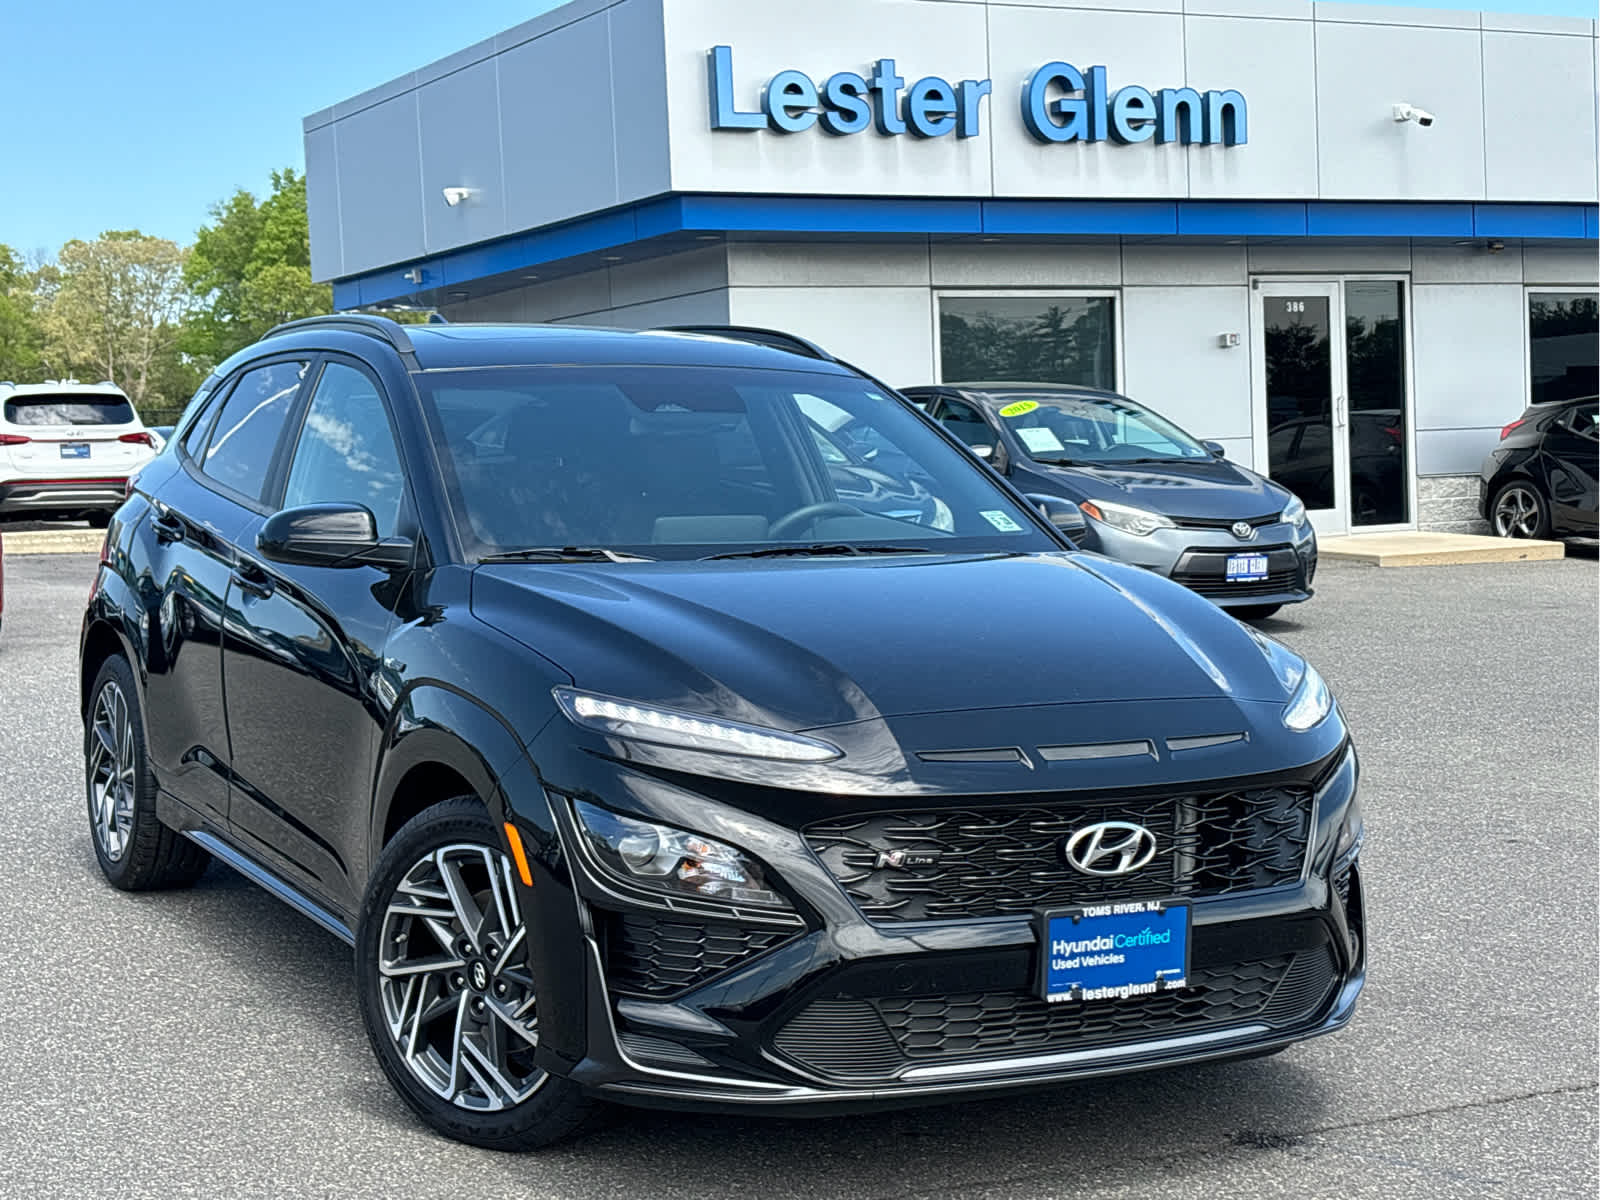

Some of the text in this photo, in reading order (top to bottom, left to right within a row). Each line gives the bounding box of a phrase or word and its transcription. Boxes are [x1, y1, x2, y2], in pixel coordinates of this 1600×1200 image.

[708, 45, 1248, 146] Lester Glenn
[1286, 301, 1305, 313] 386
[1081, 905, 1112, 918] TOMS
[1052, 928, 1171, 957] Hyundai Certified
[1052, 953, 1125, 971] Used Vehicles
